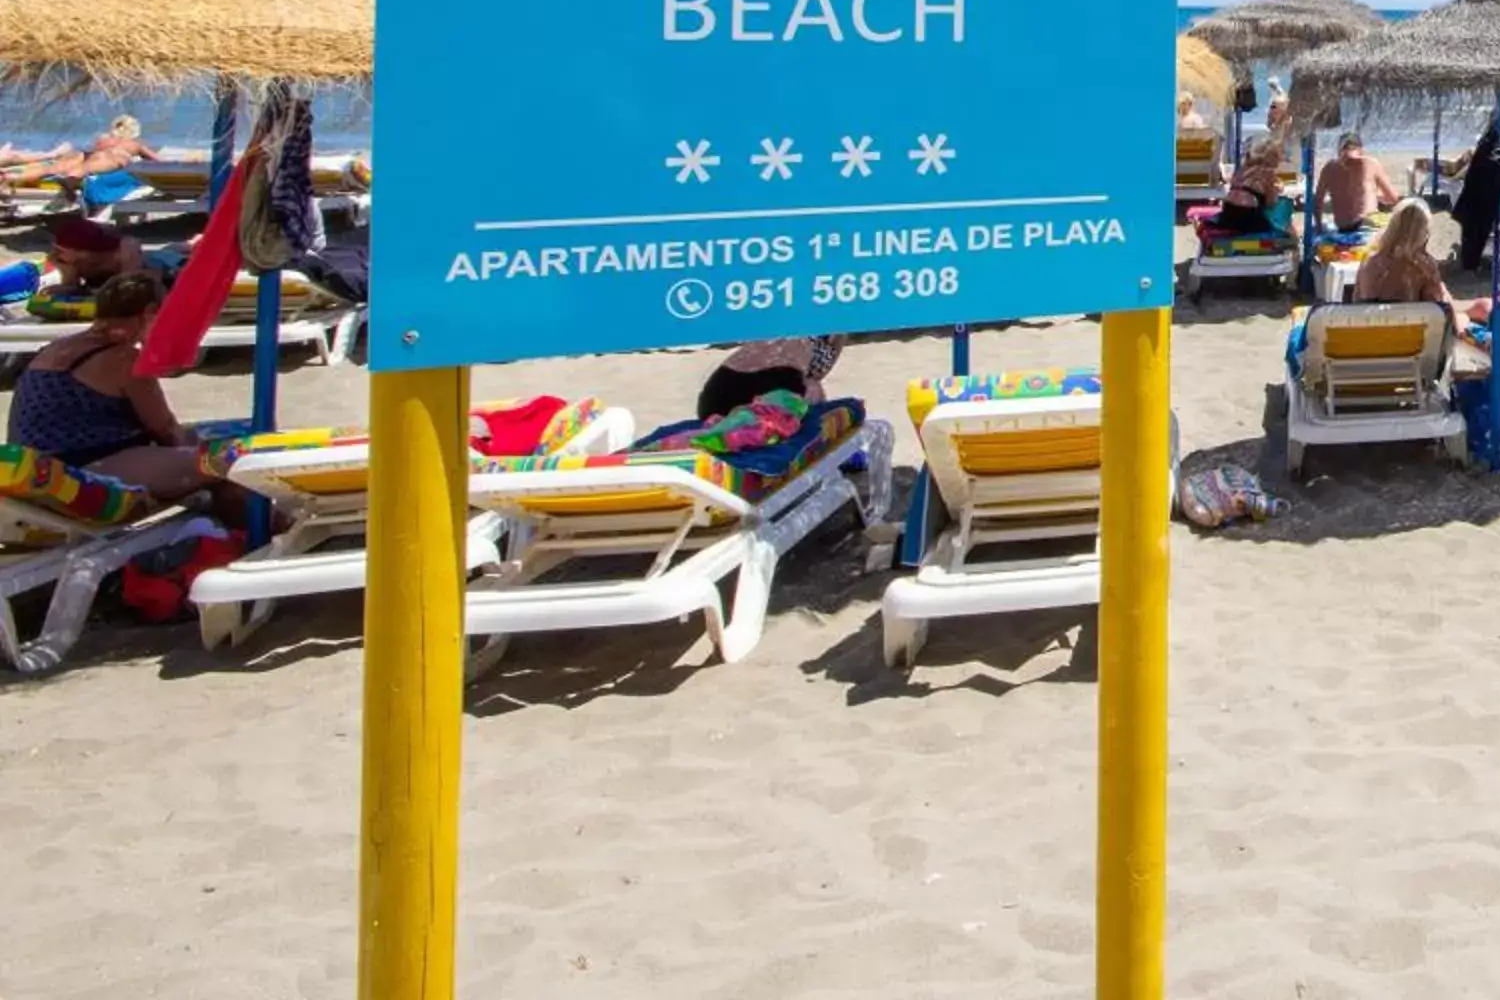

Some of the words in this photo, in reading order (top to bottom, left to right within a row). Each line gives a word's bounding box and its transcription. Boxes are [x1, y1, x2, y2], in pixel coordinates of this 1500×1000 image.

[445, 235, 795, 282] APARTAMENTOS
[852, 227, 959, 258] LINEA
[966, 224, 1013, 251] DE
[1023, 218, 1126, 248] PLAYA
[724, 277, 794, 311] 951
[812, 272, 881, 305] 568
[893, 266, 959, 299] 308
